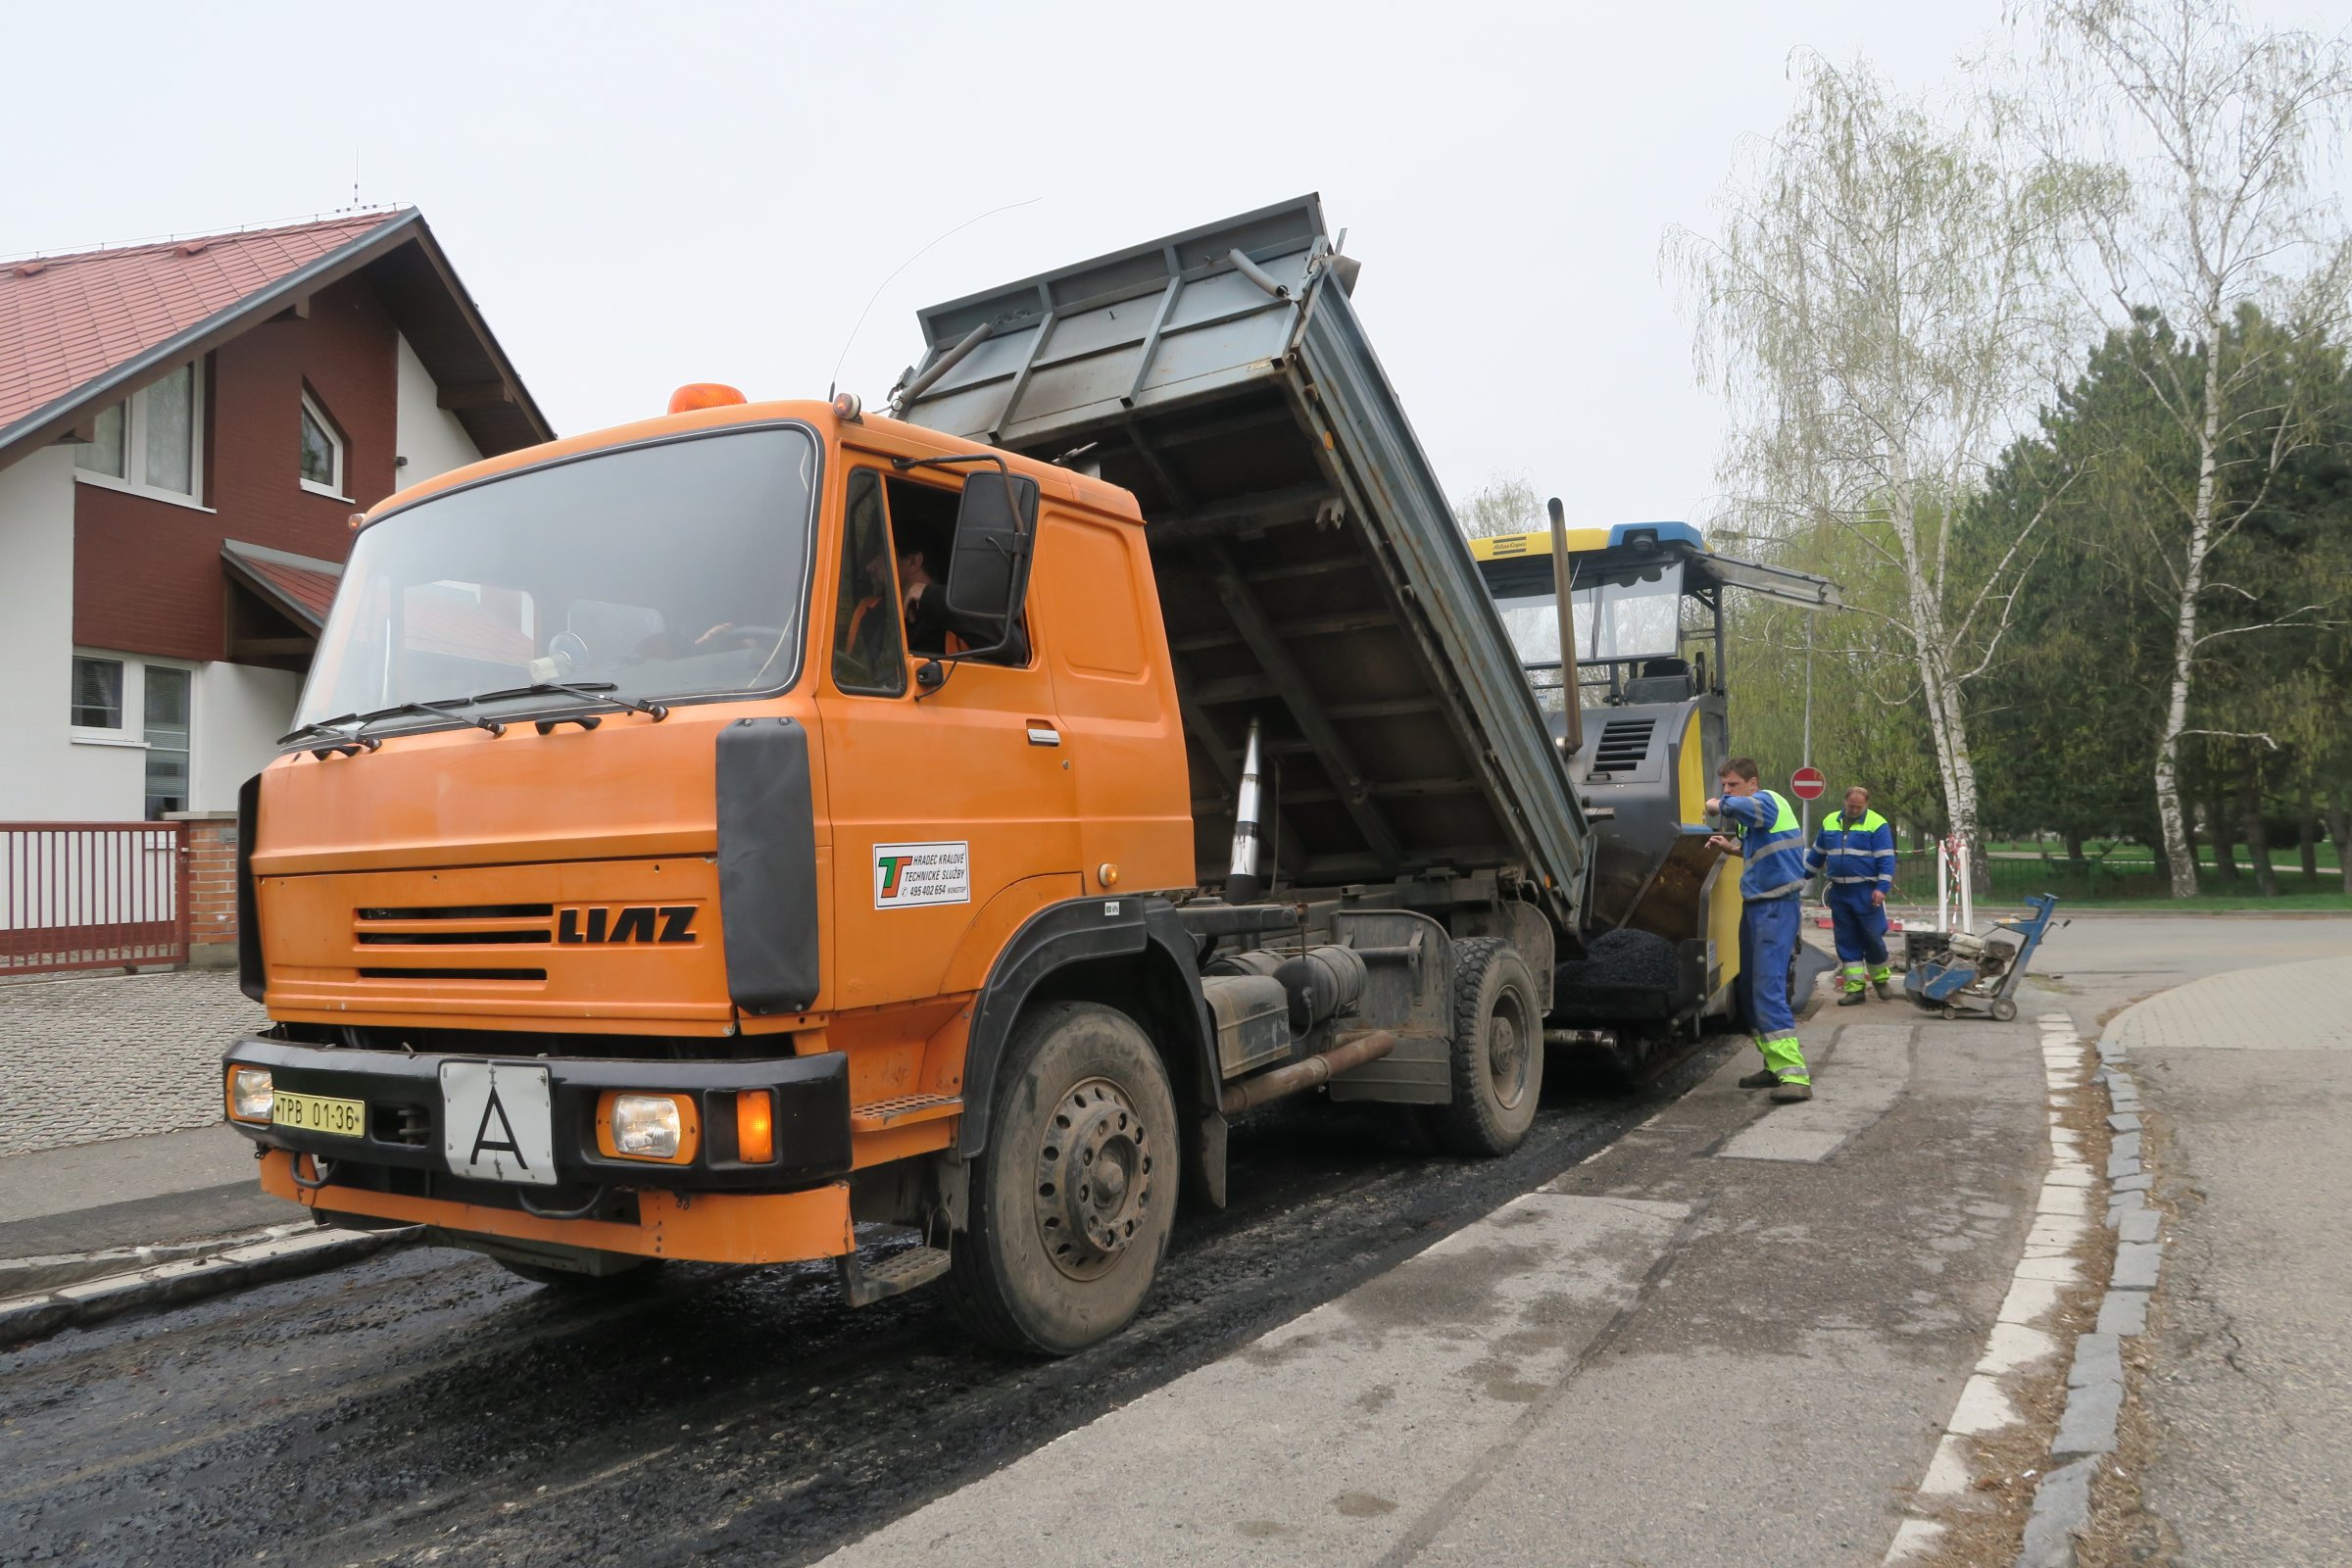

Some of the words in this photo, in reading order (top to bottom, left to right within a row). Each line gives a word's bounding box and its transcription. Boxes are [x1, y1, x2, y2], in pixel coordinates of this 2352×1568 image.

[913, 855, 938, 865] HRADEC
[939, 852, 964, 864] KRÁLOVÉ
[906, 868, 940, 882] TECHNICKÉ
[942, 866, 965, 879] SLUŽBY
[909, 886, 921, 896] 495
[922, 885, 934, 895] 402
[935, 885, 946, 894] 654
[558, 906, 699, 944] LIAZ
[280, 1097, 303, 1124] TPB
[469, 1084, 529, 1170] A
